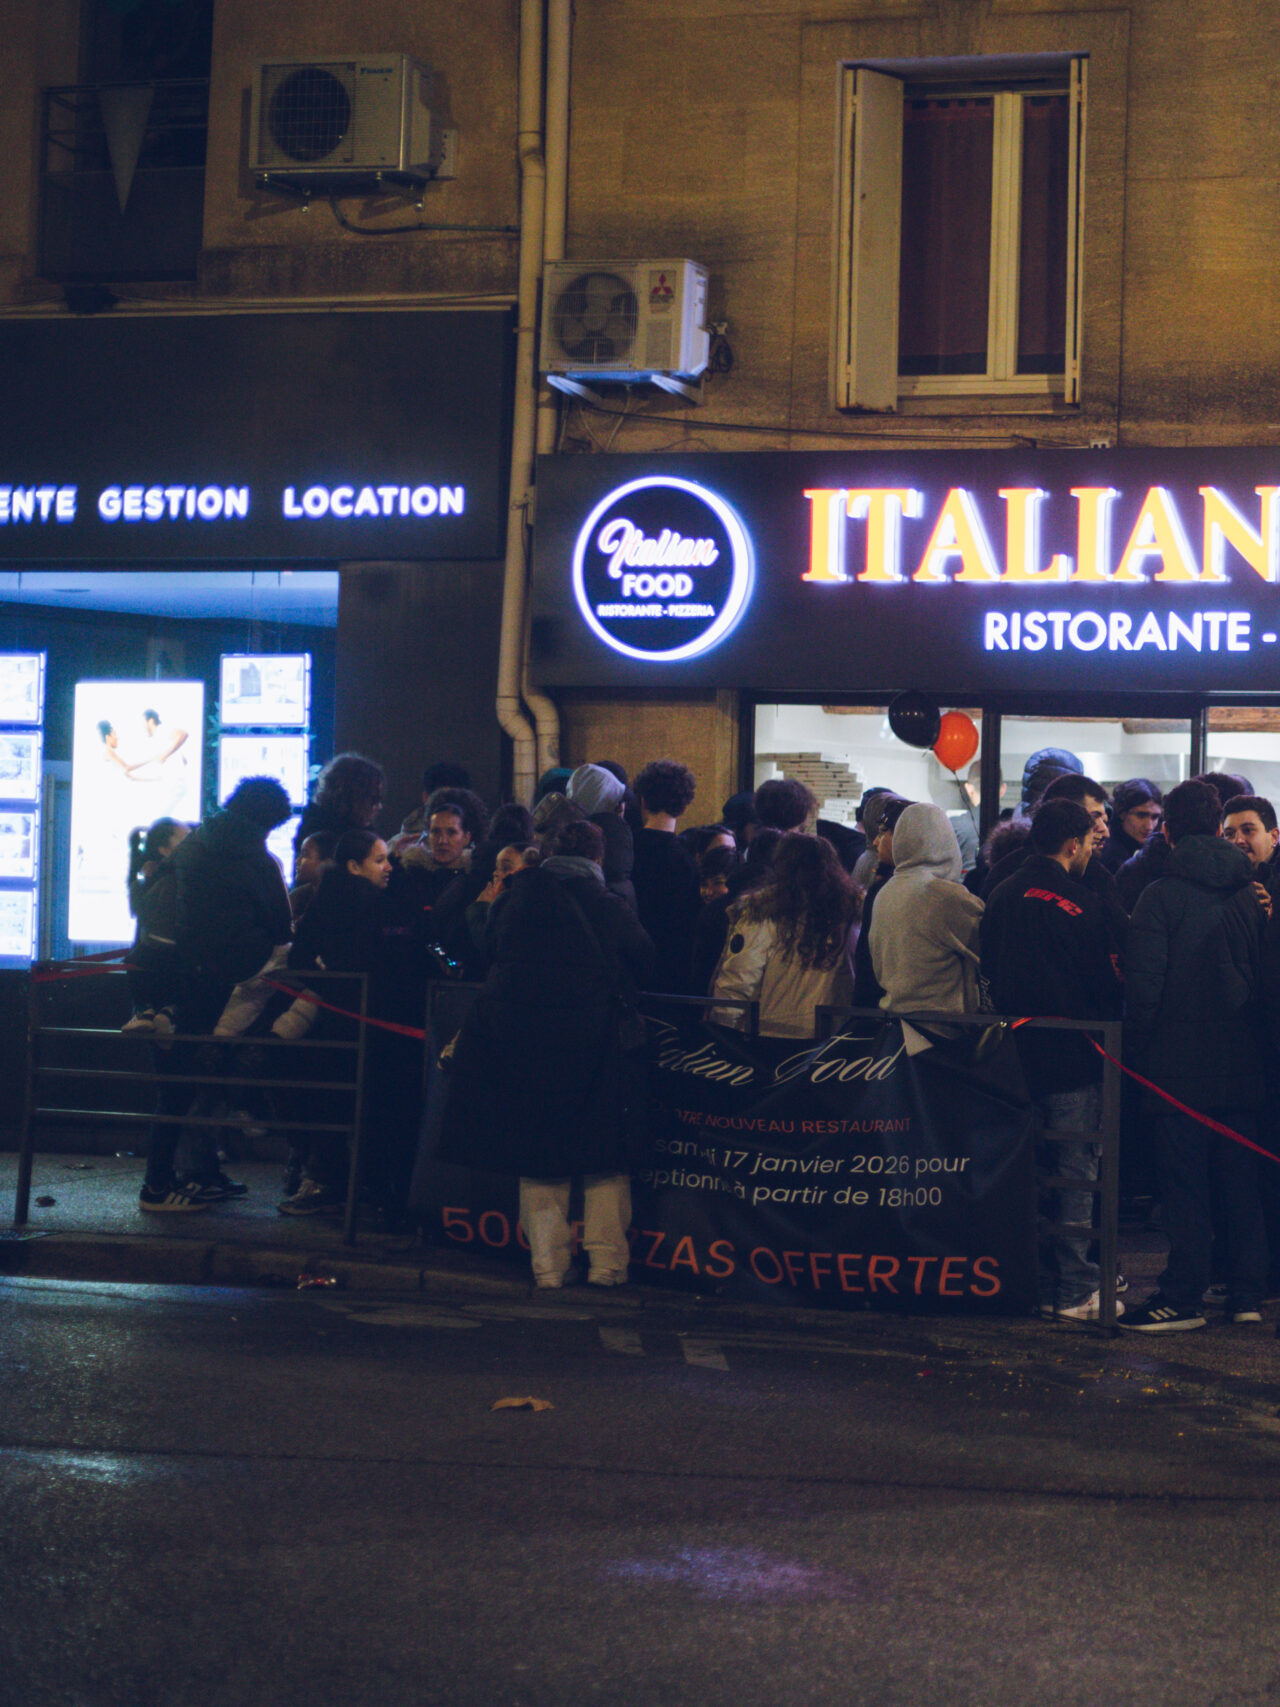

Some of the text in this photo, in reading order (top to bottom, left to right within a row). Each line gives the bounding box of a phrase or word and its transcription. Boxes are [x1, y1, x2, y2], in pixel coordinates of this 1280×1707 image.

[98, 487, 249, 519] GESTION
[283, 486, 465, 517] LOCATION
[598, 518, 719, 579] Italian
[622, 572, 694, 598] FOOD
[984, 611, 1251, 652] RISTORANTE
[762, 1031, 908, 1089] Food
[705, 1114, 795, 1134] NOUVEAU
[802, 1117, 912, 1135] RESTAURANT
[723, 1149, 750, 1168] 17
[750, 1150, 845, 1176] janvier
[849, 1154, 910, 1175] 2026
[915, 1154, 970, 1179] pour
[752, 1185, 828, 1207] partir
[833, 1186, 869, 1206] de
[879, 1186, 942, 1207] 18h00
[749, 1245, 1002, 1297] OFFERTES
